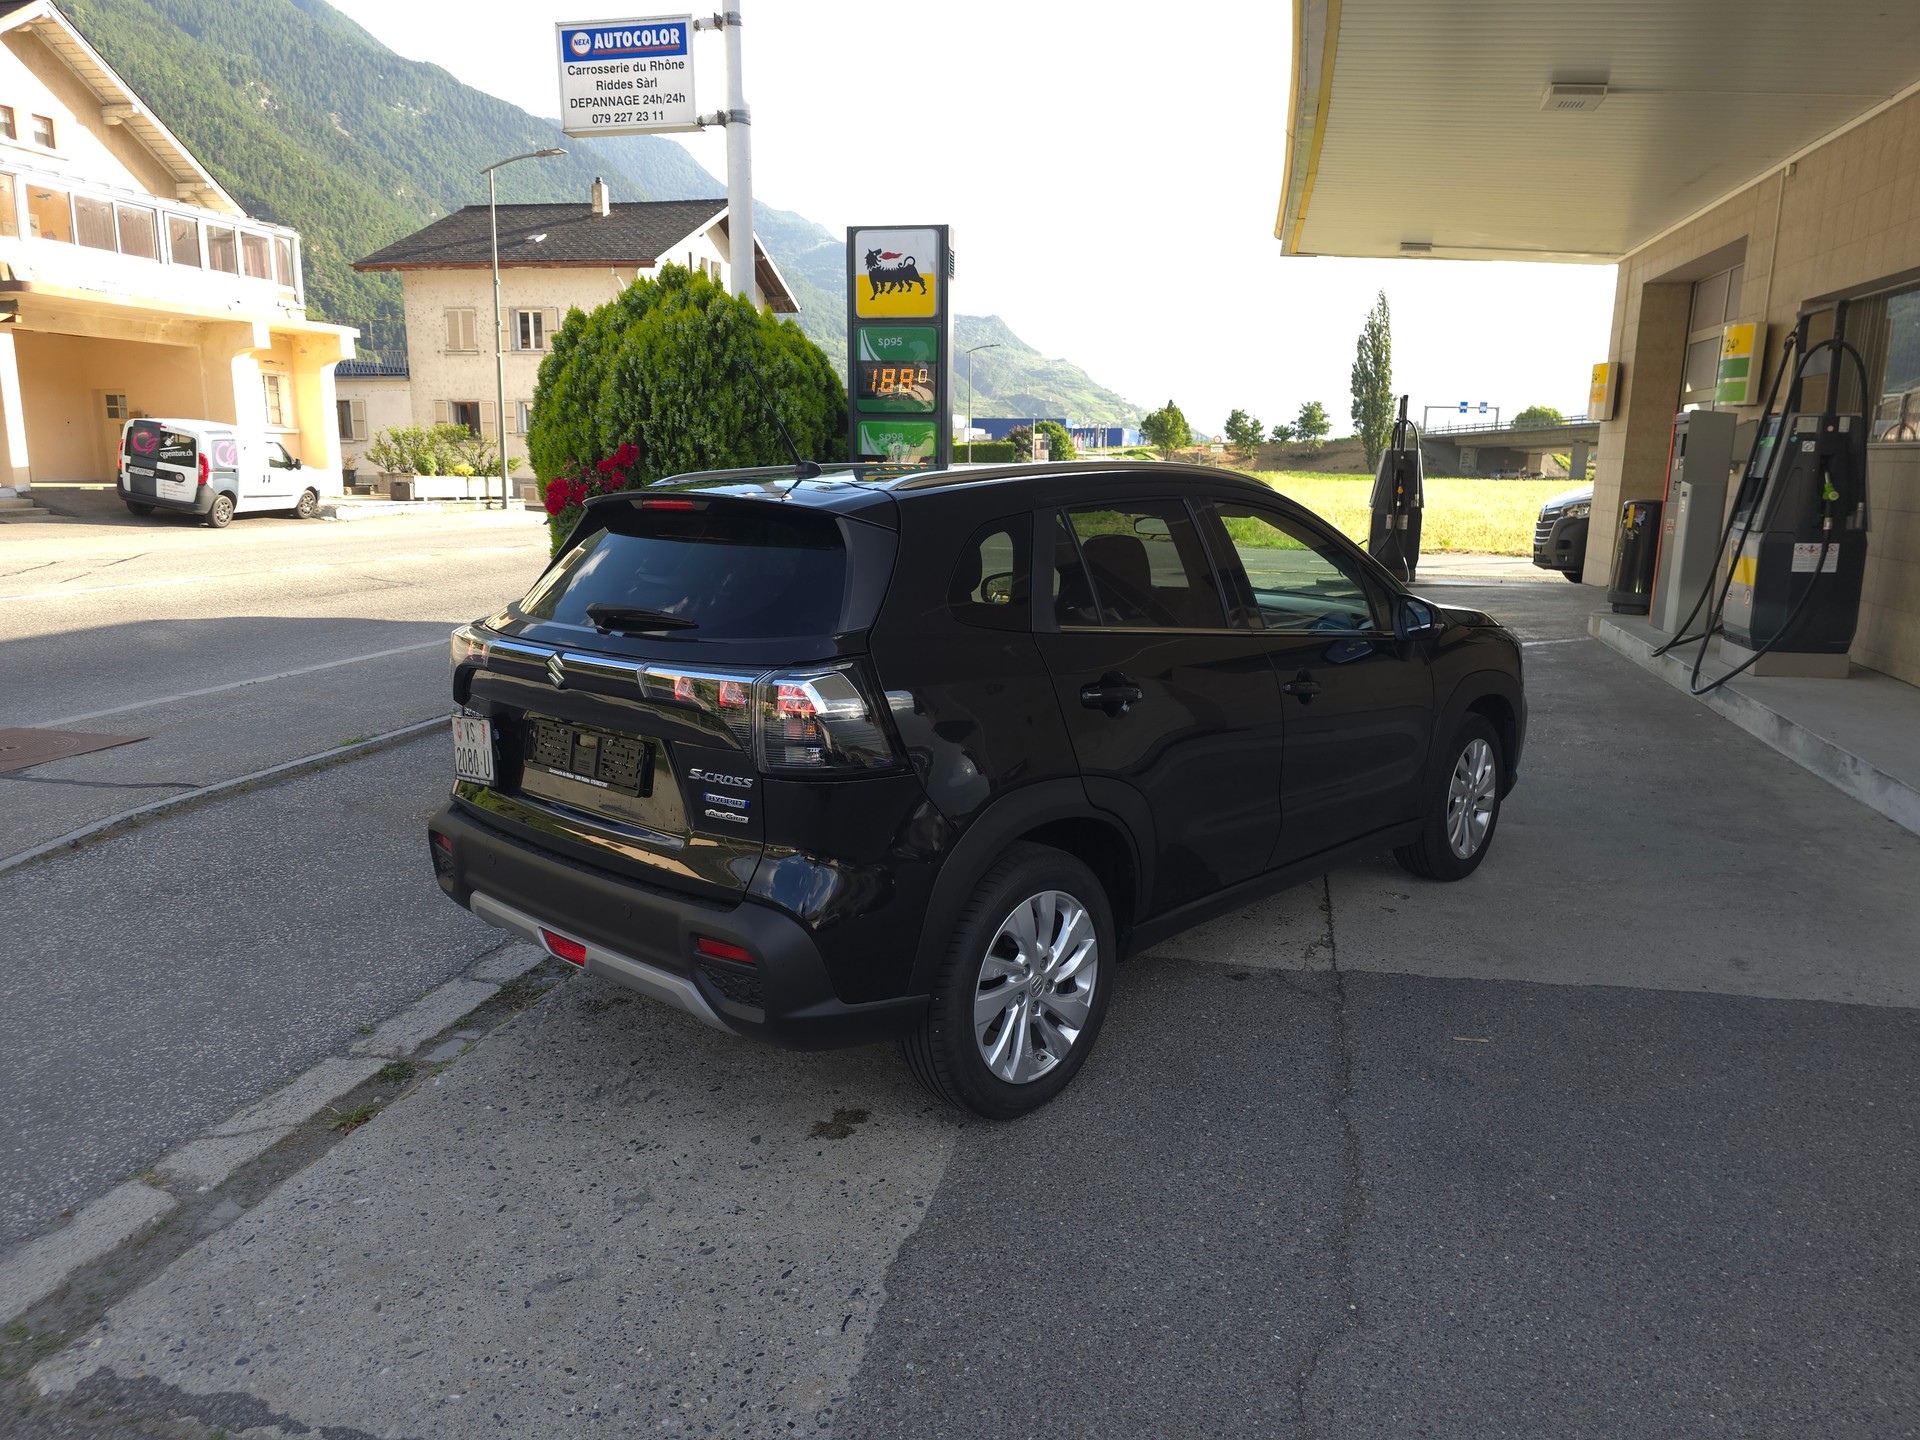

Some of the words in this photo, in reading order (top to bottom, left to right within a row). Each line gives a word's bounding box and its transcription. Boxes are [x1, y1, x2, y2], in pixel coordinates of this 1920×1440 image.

[573, 38, 590, 46] NEXA
[594, 28, 680, 49] AUTOCOLOR
[567, 62, 630, 76] Carrosserie
[633, 61, 647, 72] du
[650, 59, 685, 71] Rhône
[596, 79, 633, 91] Riddes
[636, 77, 658, 89] Sàrl
[570, 95, 640, 109] DEPANNAGE
[643, 92, 686, 105] 24h/24h
[592, 113, 611, 124] 079
[614, 112, 632, 123] 227
[636, 111, 649, 122] 23
[653, 110, 664, 121] 11
[878, 337, 903, 349] sp95
[879, 432, 904, 443] sp98
[159, 449, 193, 459] cgpeinture.ch
[464, 721, 475, 743] VS
[707, 794, 744, 807] HYBRID
